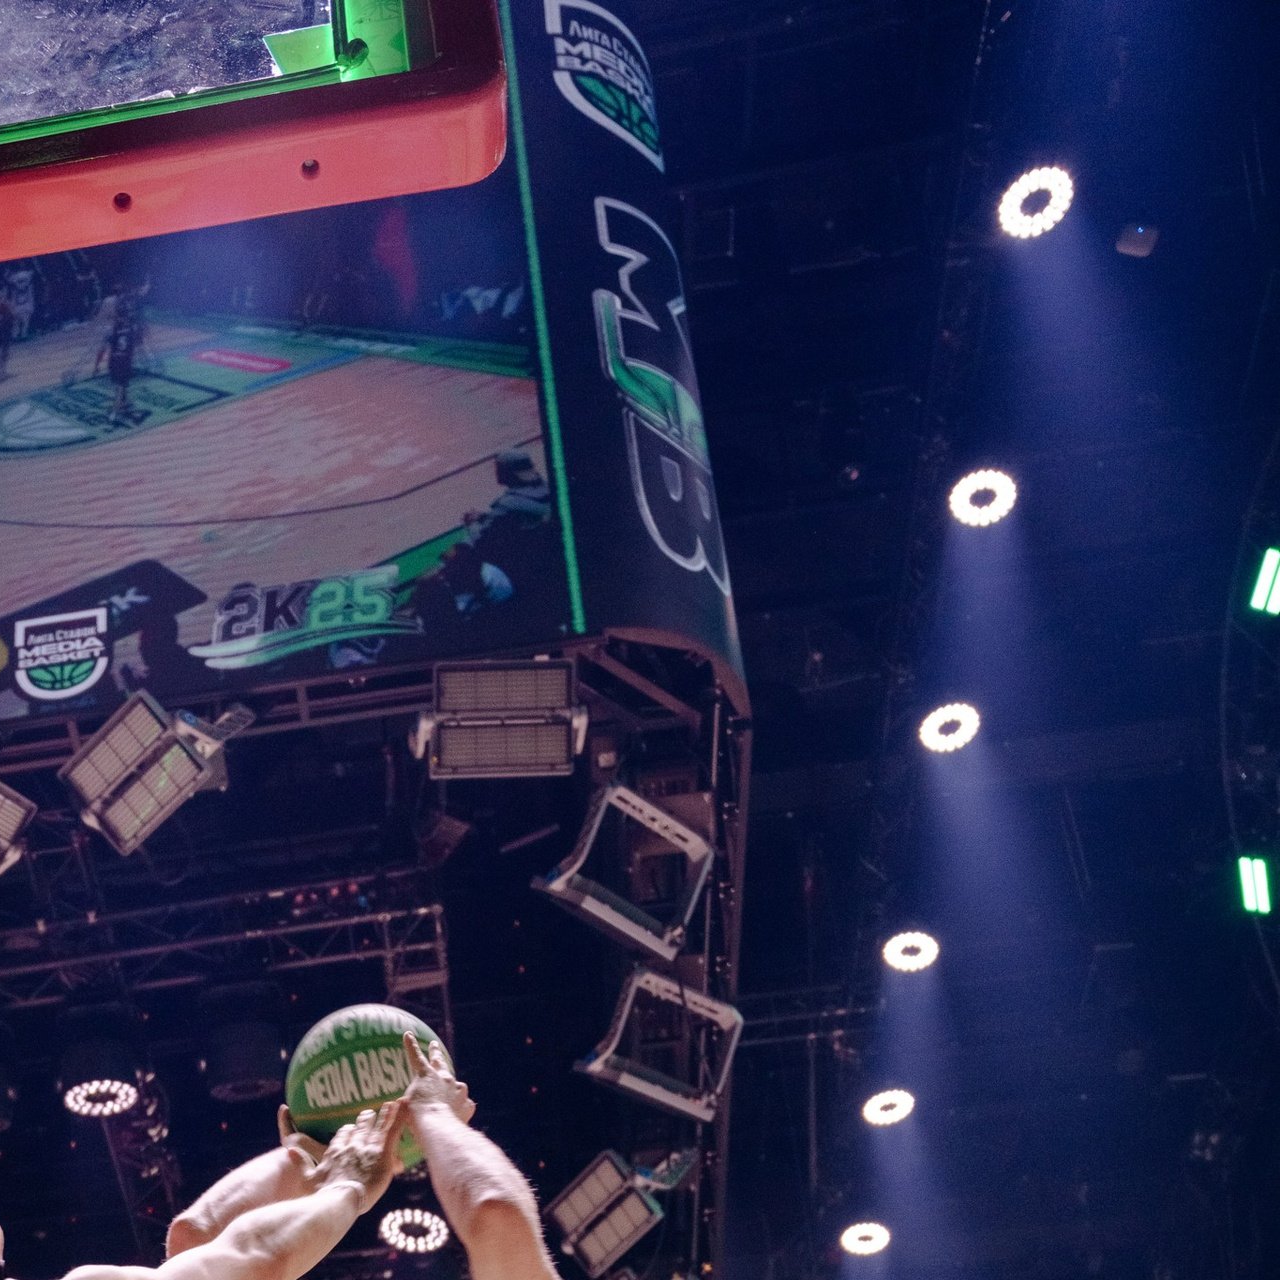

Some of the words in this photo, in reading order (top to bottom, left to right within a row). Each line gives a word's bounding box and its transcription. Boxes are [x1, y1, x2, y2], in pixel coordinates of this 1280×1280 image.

[17, 636, 105, 660] MEDIA
[17, 647, 106, 669] BASKET
[304, 1055, 360, 1108] MEDIA
